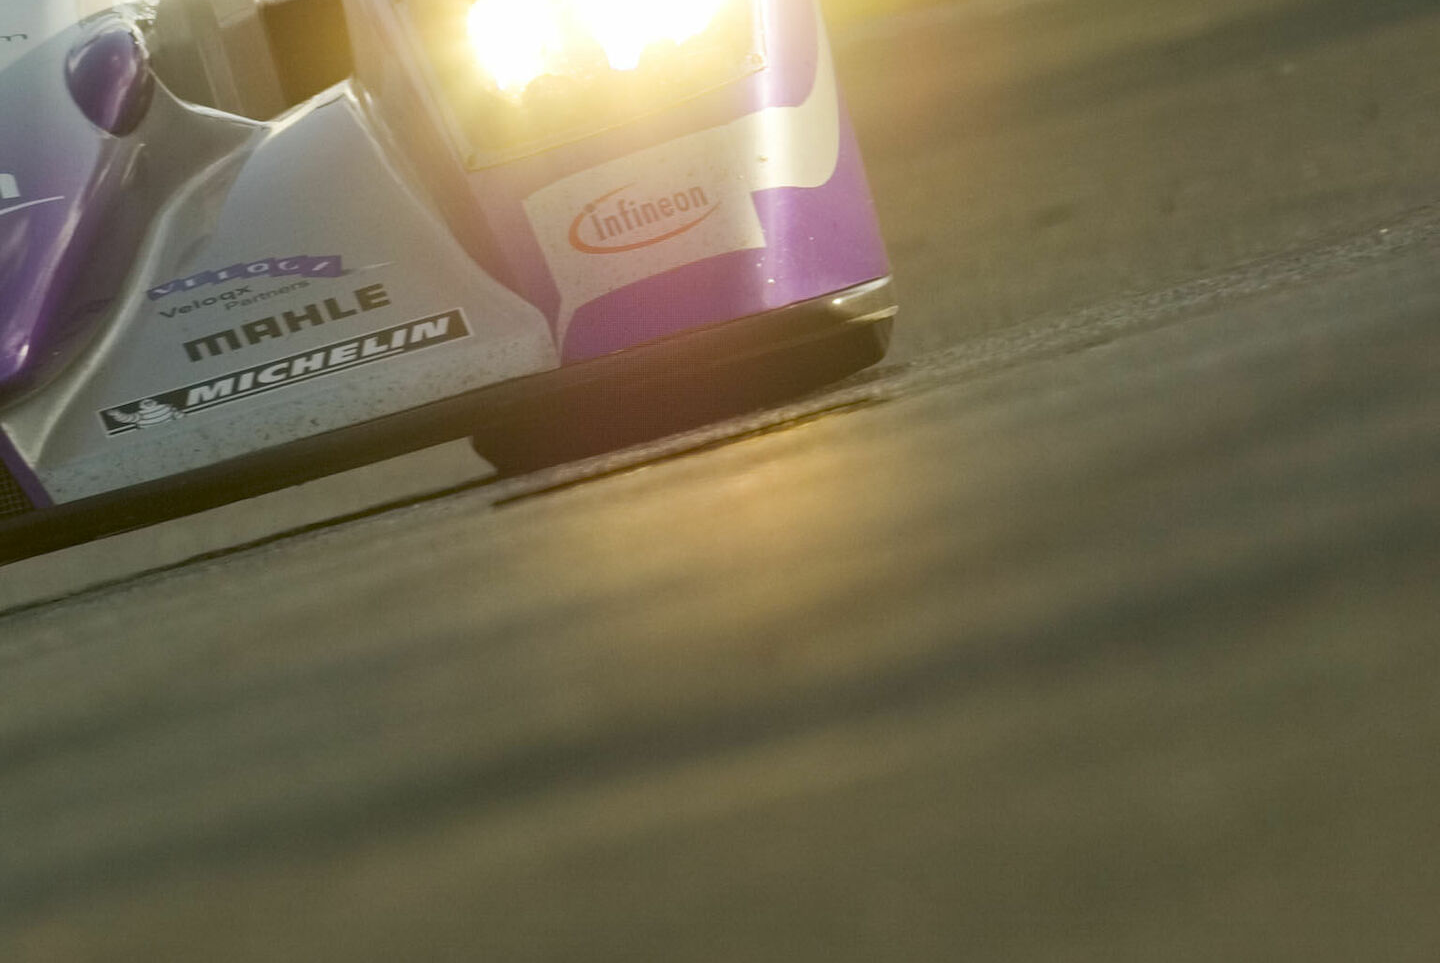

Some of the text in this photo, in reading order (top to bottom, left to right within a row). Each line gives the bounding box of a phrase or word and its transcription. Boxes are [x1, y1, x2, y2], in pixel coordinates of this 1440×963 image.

[159, 284, 252, 320] Veloqx
[183, 283, 391, 363] MAHLE
[225, 280, 310, 311] Partners
[185, 315, 451, 407] MICHELIN
